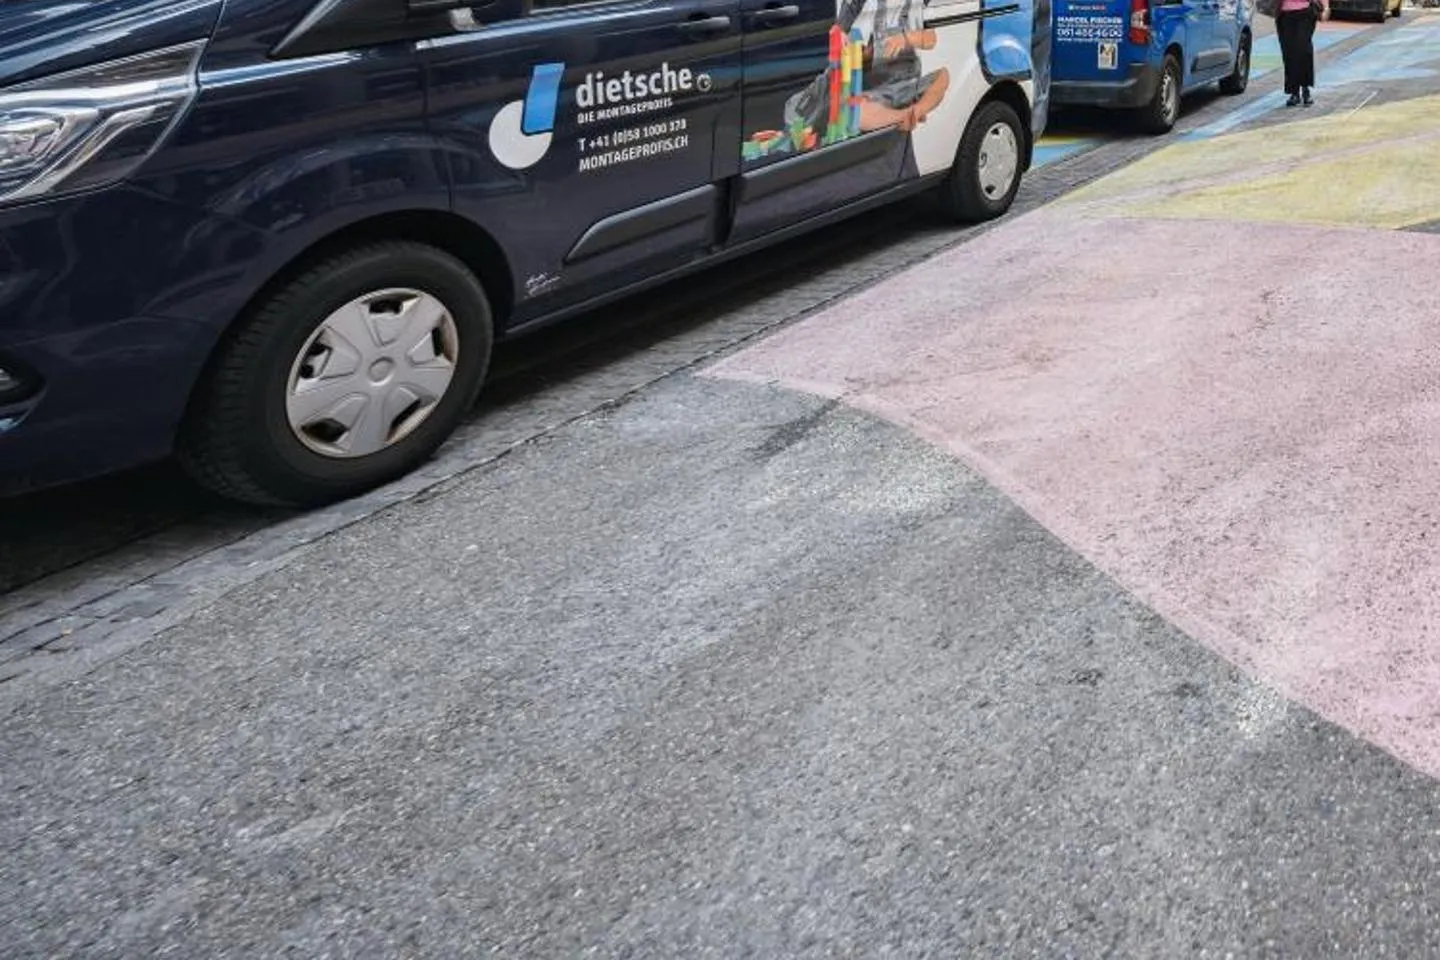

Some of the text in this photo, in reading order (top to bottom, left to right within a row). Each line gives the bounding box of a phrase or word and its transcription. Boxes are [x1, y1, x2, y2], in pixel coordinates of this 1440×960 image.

[575, 61, 692, 108] dietsche
[577, 97, 673, 124] DIE MONTAGEPROFIS
[577, 137, 587, 152] T
[589, 134, 609, 149] +41
[642, 122, 667, 139] 1000
[579, 134, 689, 172] MONTAGEPROFIS.CH
